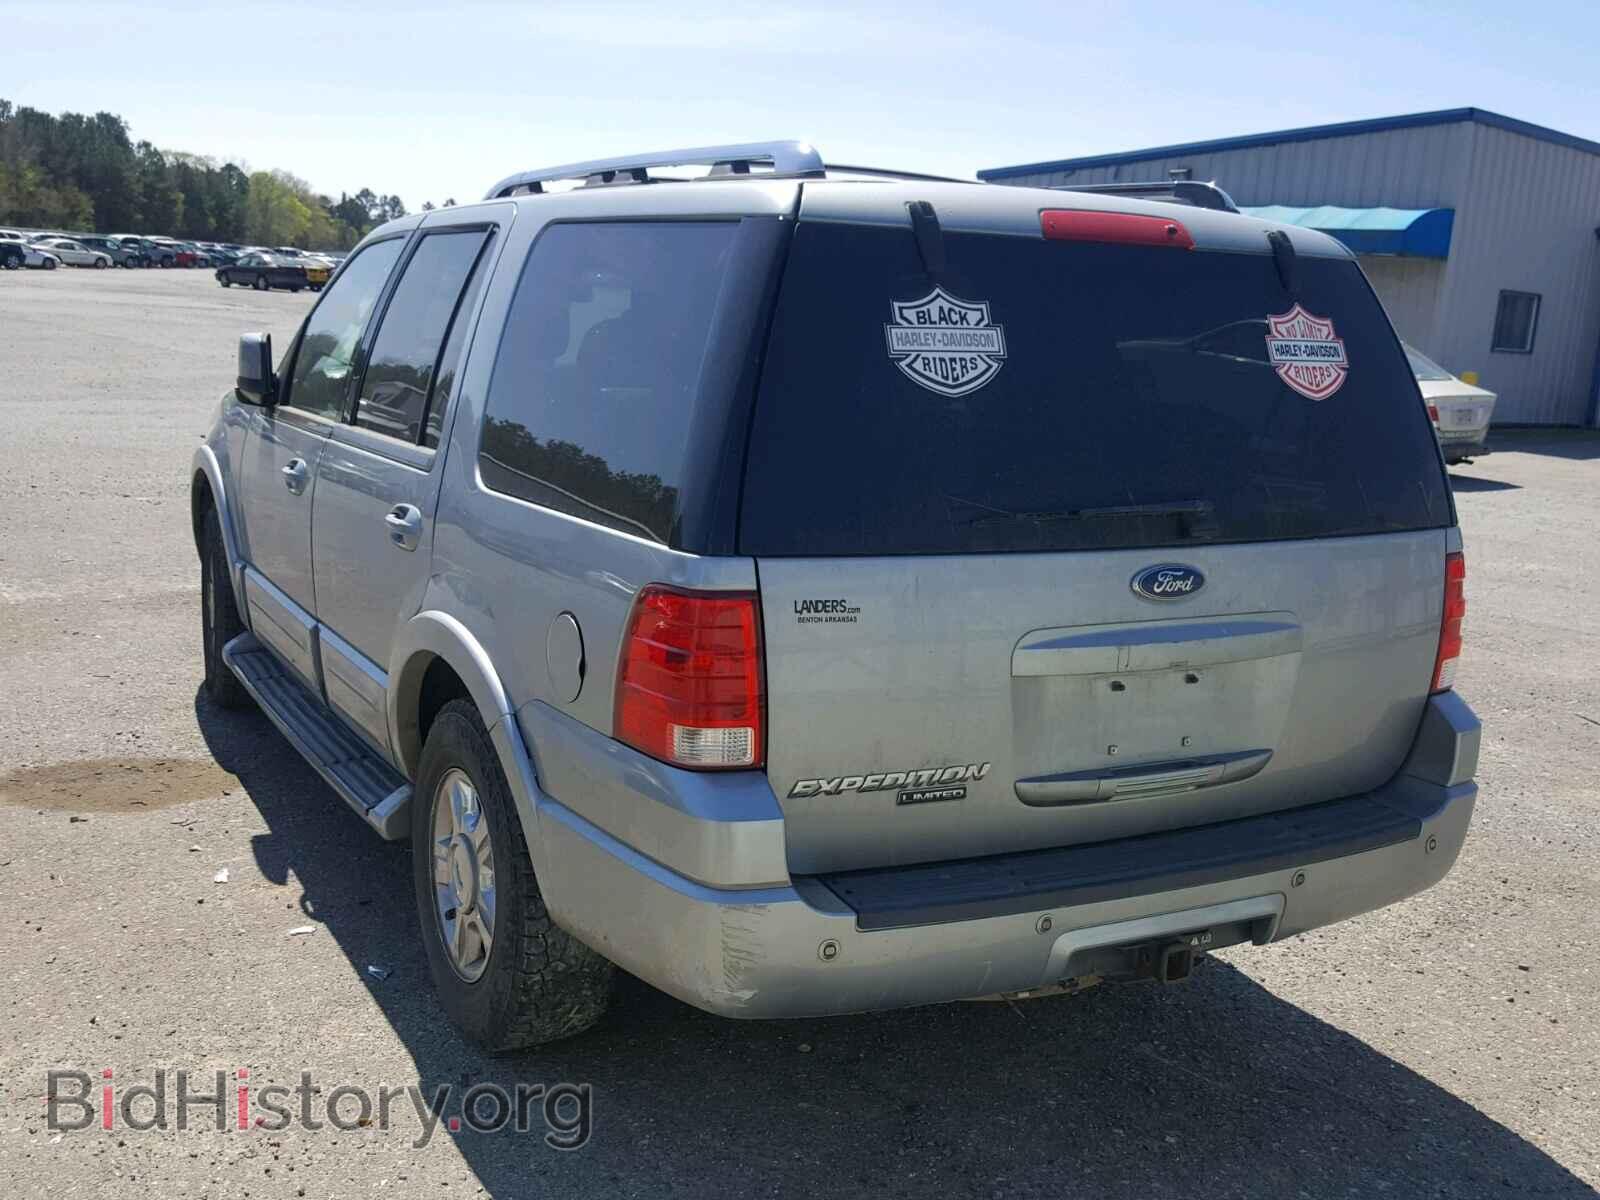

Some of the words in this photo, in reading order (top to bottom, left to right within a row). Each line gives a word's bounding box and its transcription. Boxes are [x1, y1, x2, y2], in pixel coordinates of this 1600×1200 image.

[915, 305, 971, 326] BLACK
[894, 331, 996, 348] HARLEY-DAVIDSON
[1285, 324, 1297, 338] NO
[1273, 343, 1341, 358] HARLEY-DAVIDSON
[921, 356, 979, 384] RIDERS
[1293, 365, 1332, 388] RIDERS
[1153, 570, 1194, 593] Ford
[797, 616, 823, 624] BENTON
[824, 615, 858, 623] ARKANSAS
[787, 761, 991, 799] EXPEDITION
[901, 788, 964, 802] LIMITED
